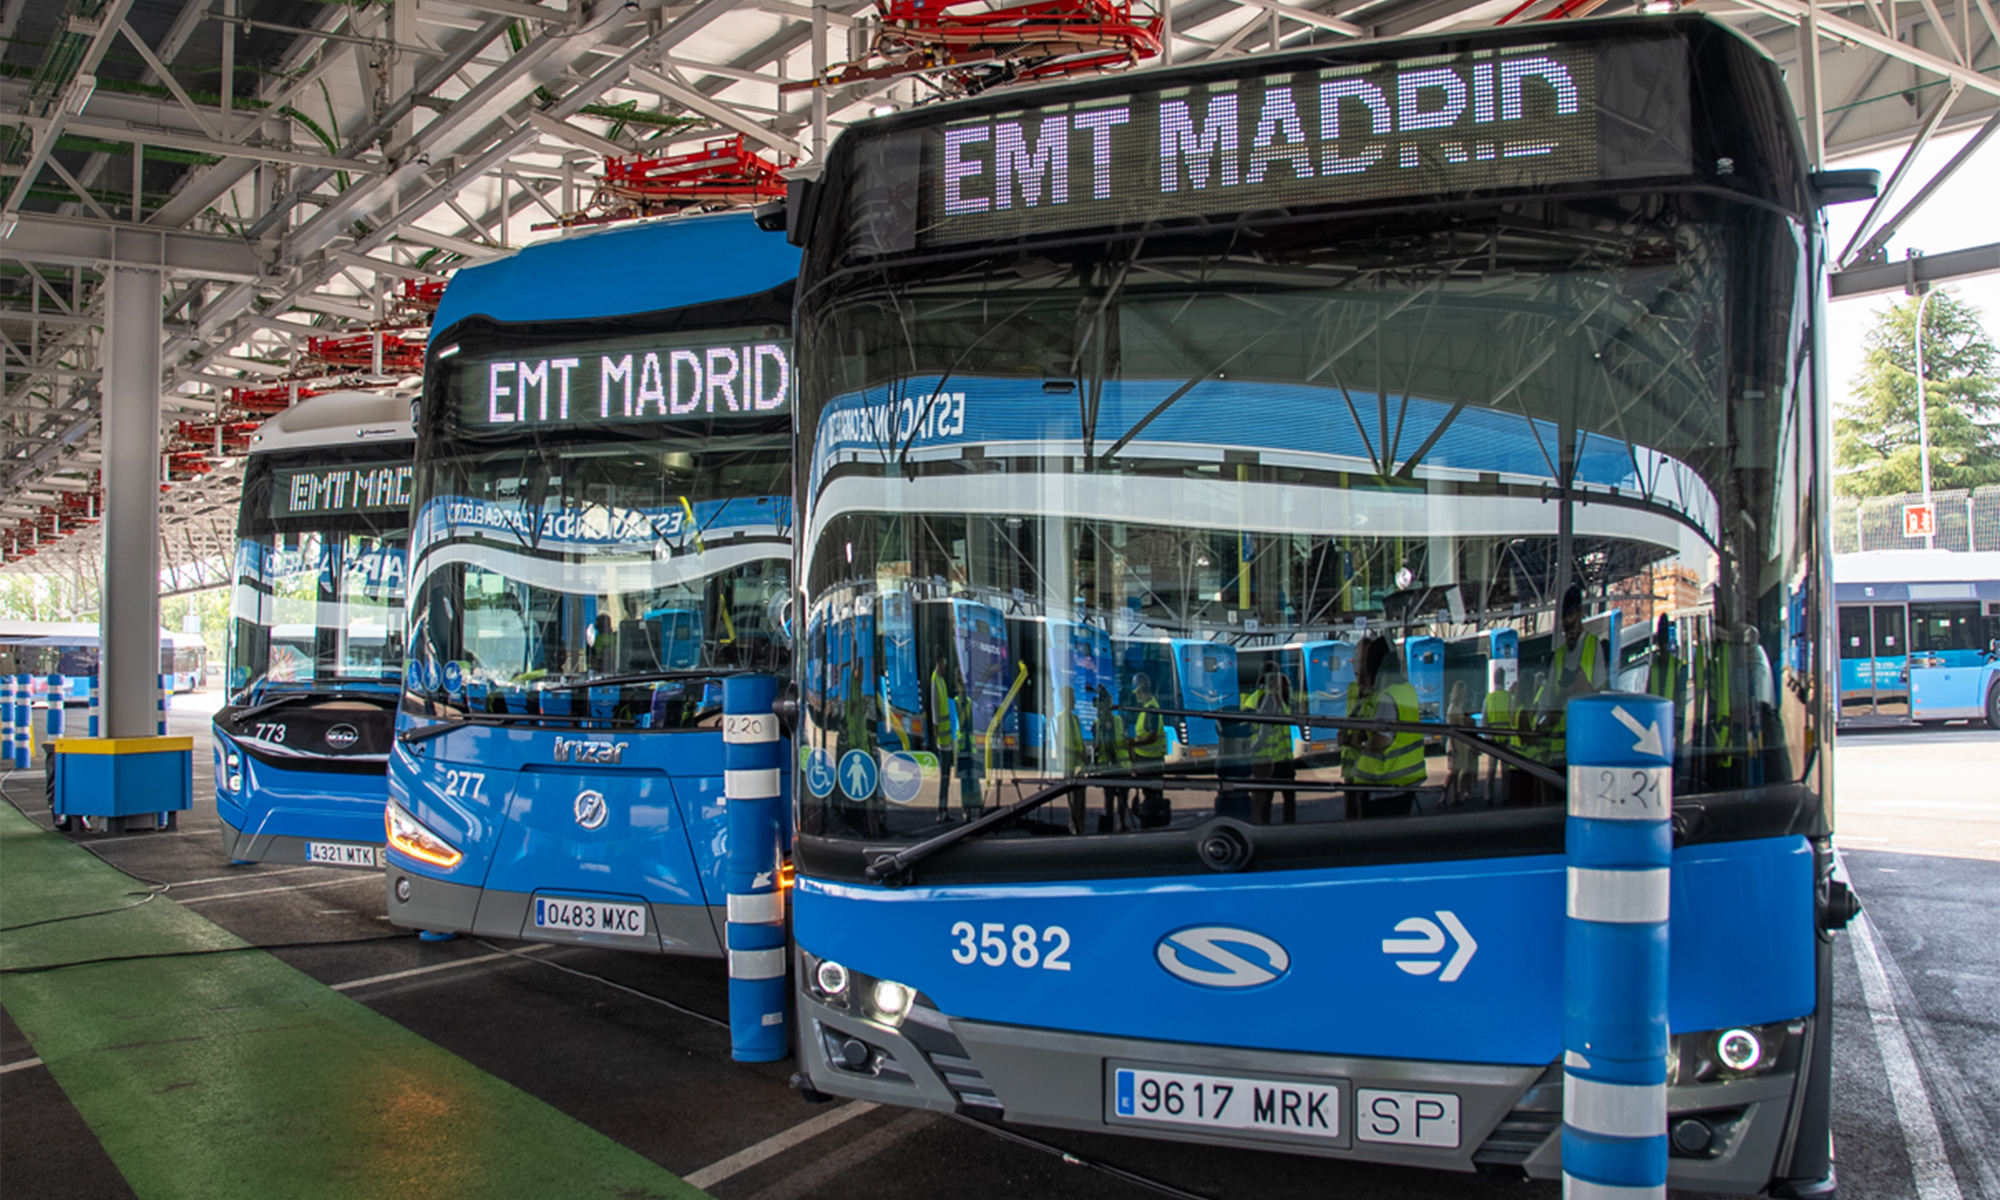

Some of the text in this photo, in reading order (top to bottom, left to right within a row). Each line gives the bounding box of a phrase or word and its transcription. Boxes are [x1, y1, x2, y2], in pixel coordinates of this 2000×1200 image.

[944, 56, 1578, 216] EMT MADRID
[489, 344, 789, 423] EMT MADRID
[289, 471, 351, 511] EMT
[255, 723, 287, 743] 773
[554, 736, 629, 764] irizar
[445, 769, 486, 800] 277
[1597, 770, 1662, 809] 2.21
[313, 845, 342, 862] 4321
[548, 903, 640, 932] 0483 MXC
[950, 921, 1072, 971] 3582
[1140, 1078, 1235, 1120] 9617
[1253, 1086, 1331, 1129] MRK
